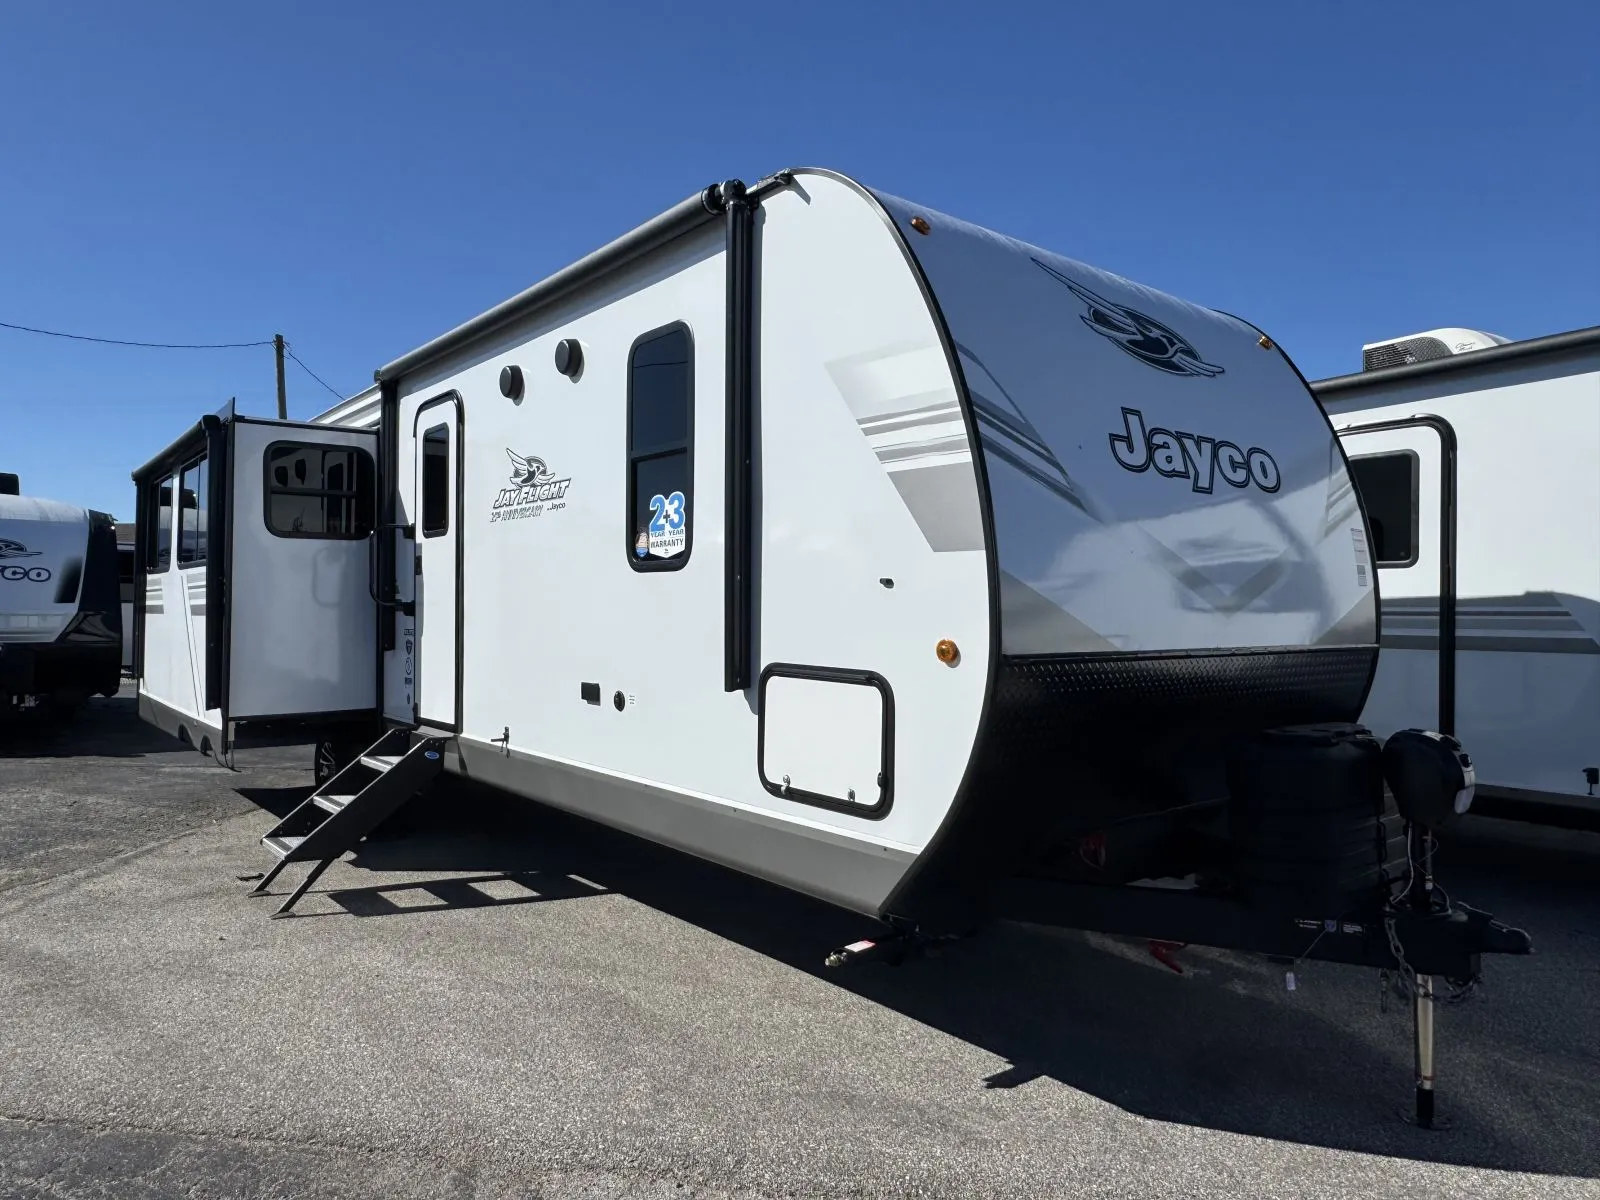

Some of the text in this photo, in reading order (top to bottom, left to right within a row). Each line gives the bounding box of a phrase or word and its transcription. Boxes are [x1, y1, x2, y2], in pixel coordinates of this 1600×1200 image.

[1109, 406, 1281, 494] Jayco
[493, 478, 571, 509] JAY FLIGHT
[668, 529, 684, 537] YEAR
[650, 538, 684, 548] WARRANTY
[0, 565, 52, 583] co
